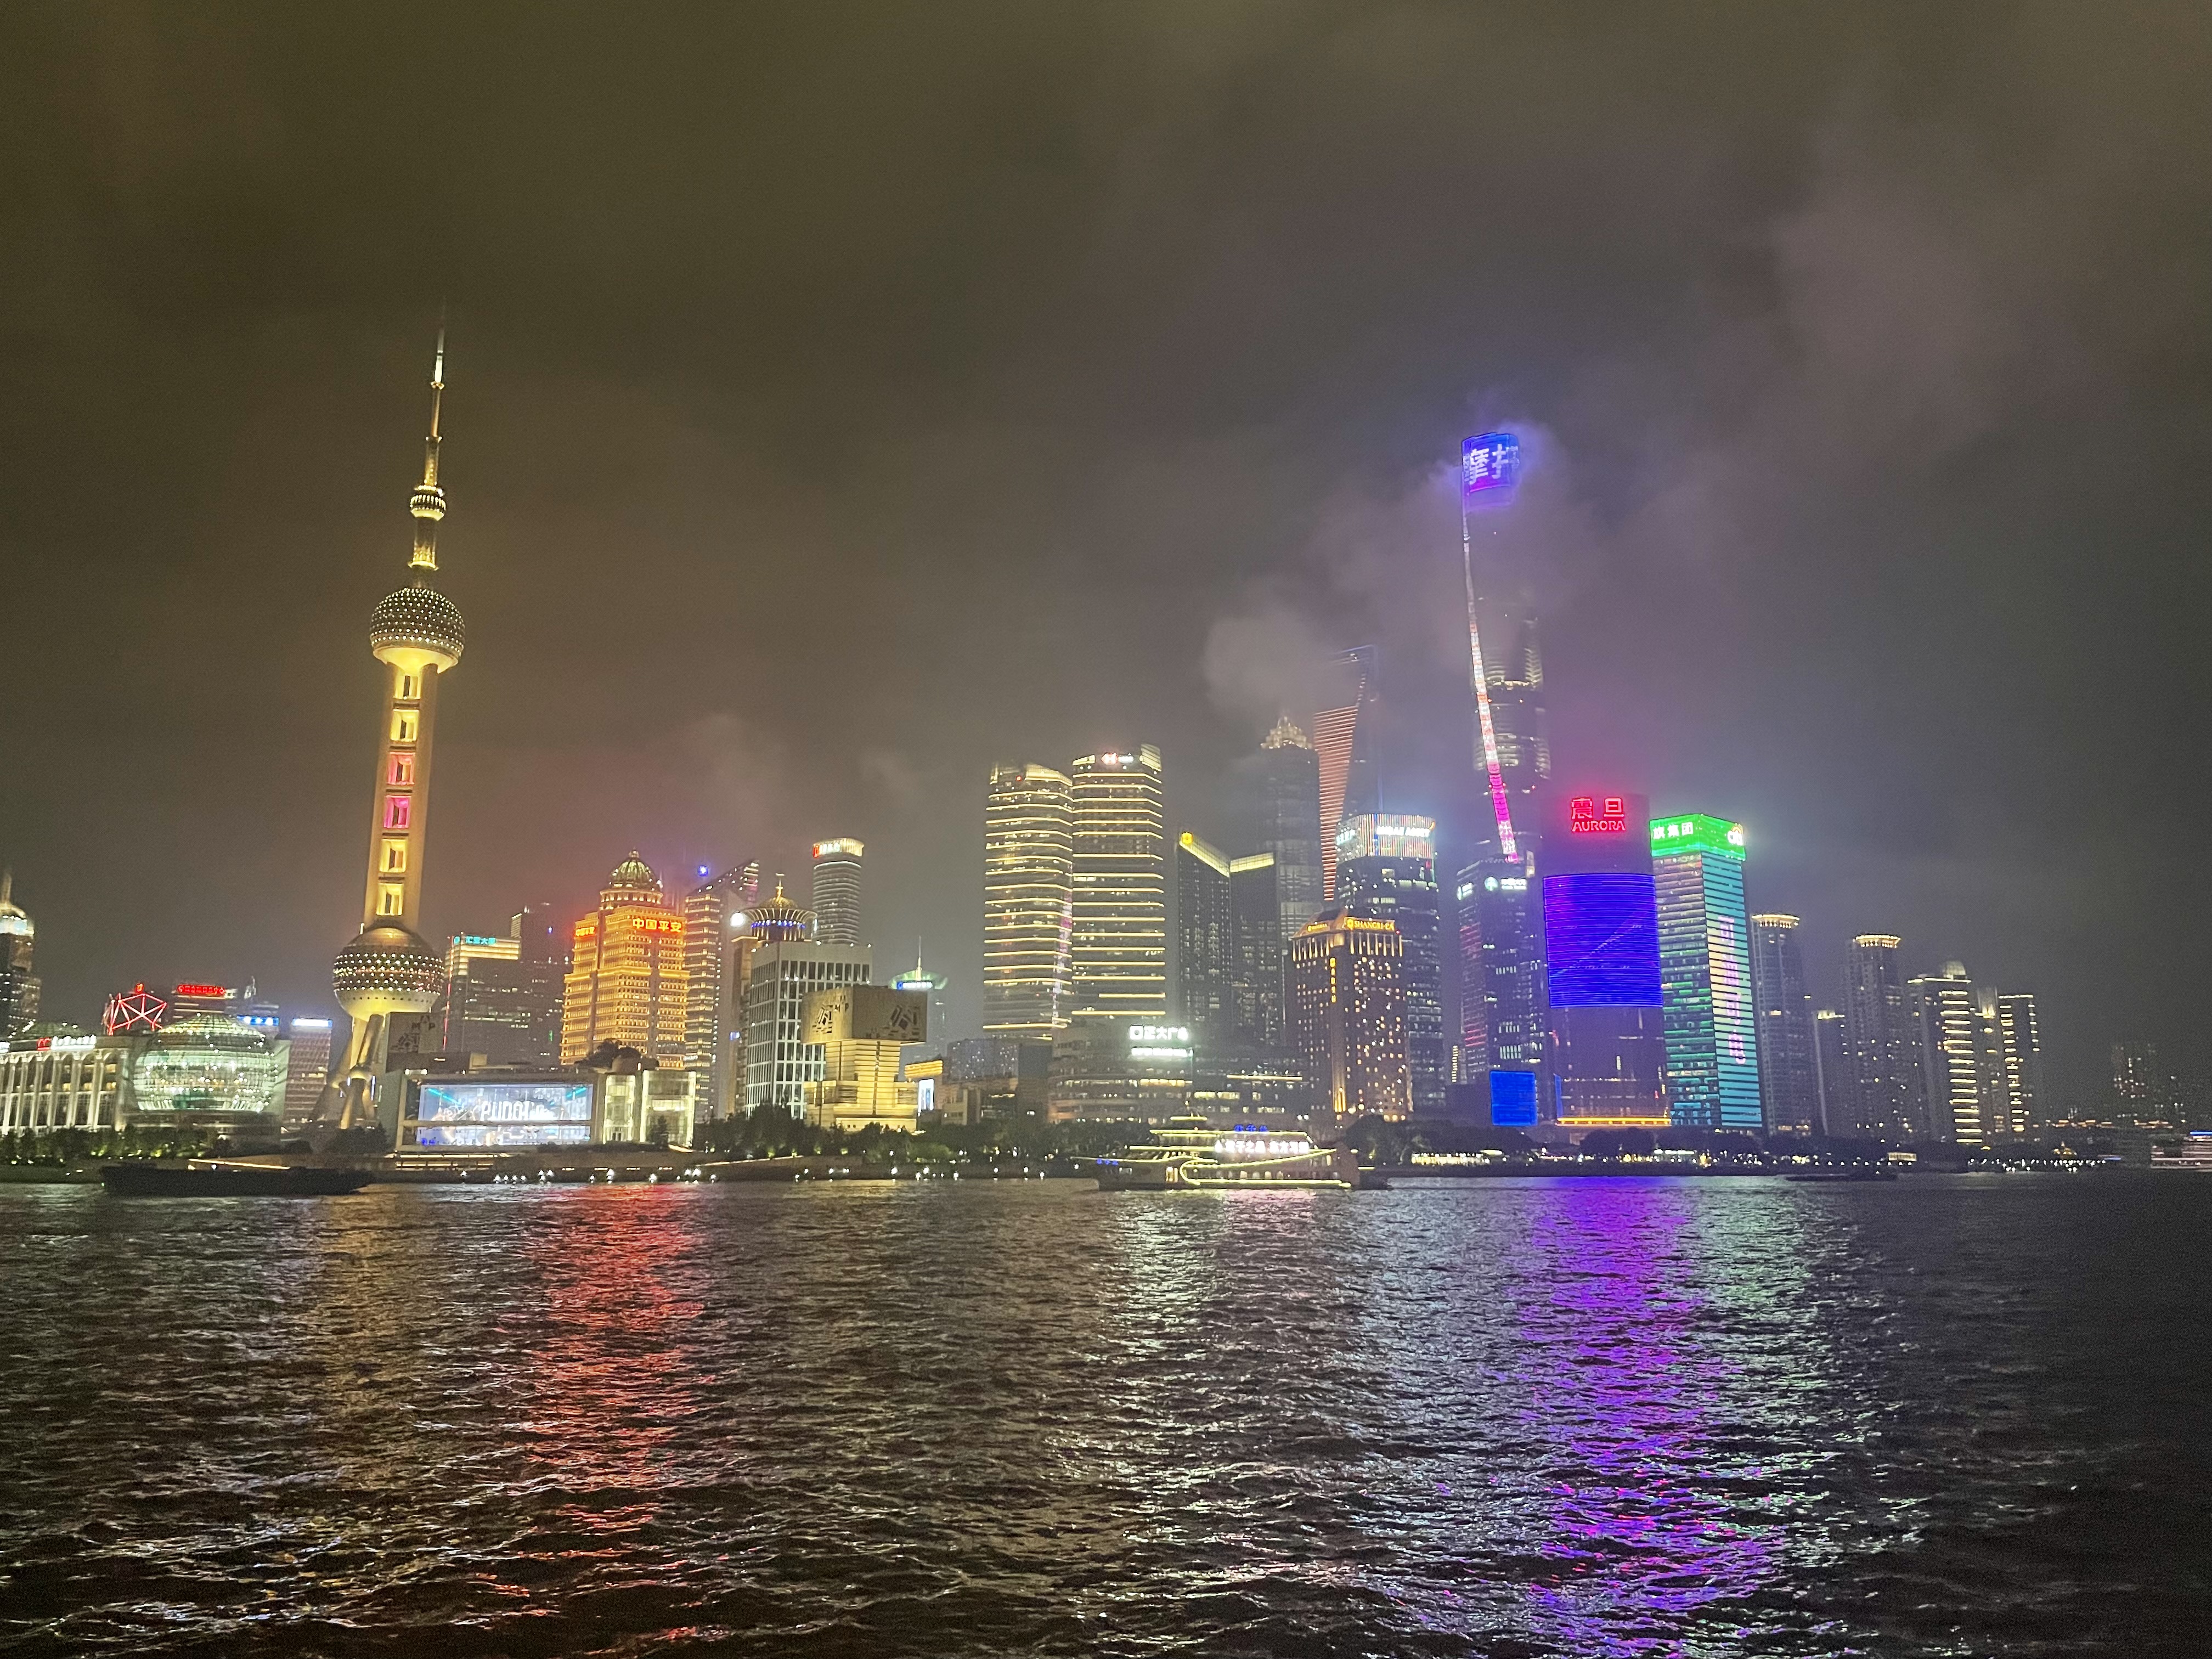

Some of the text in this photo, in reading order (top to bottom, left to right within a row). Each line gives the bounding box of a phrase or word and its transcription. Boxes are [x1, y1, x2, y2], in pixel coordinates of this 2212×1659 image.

[1572, 798, 1624, 819] 震旦
[1572, 821, 1626, 832] AURORA
[633, 918, 682, 933] 中国平安
